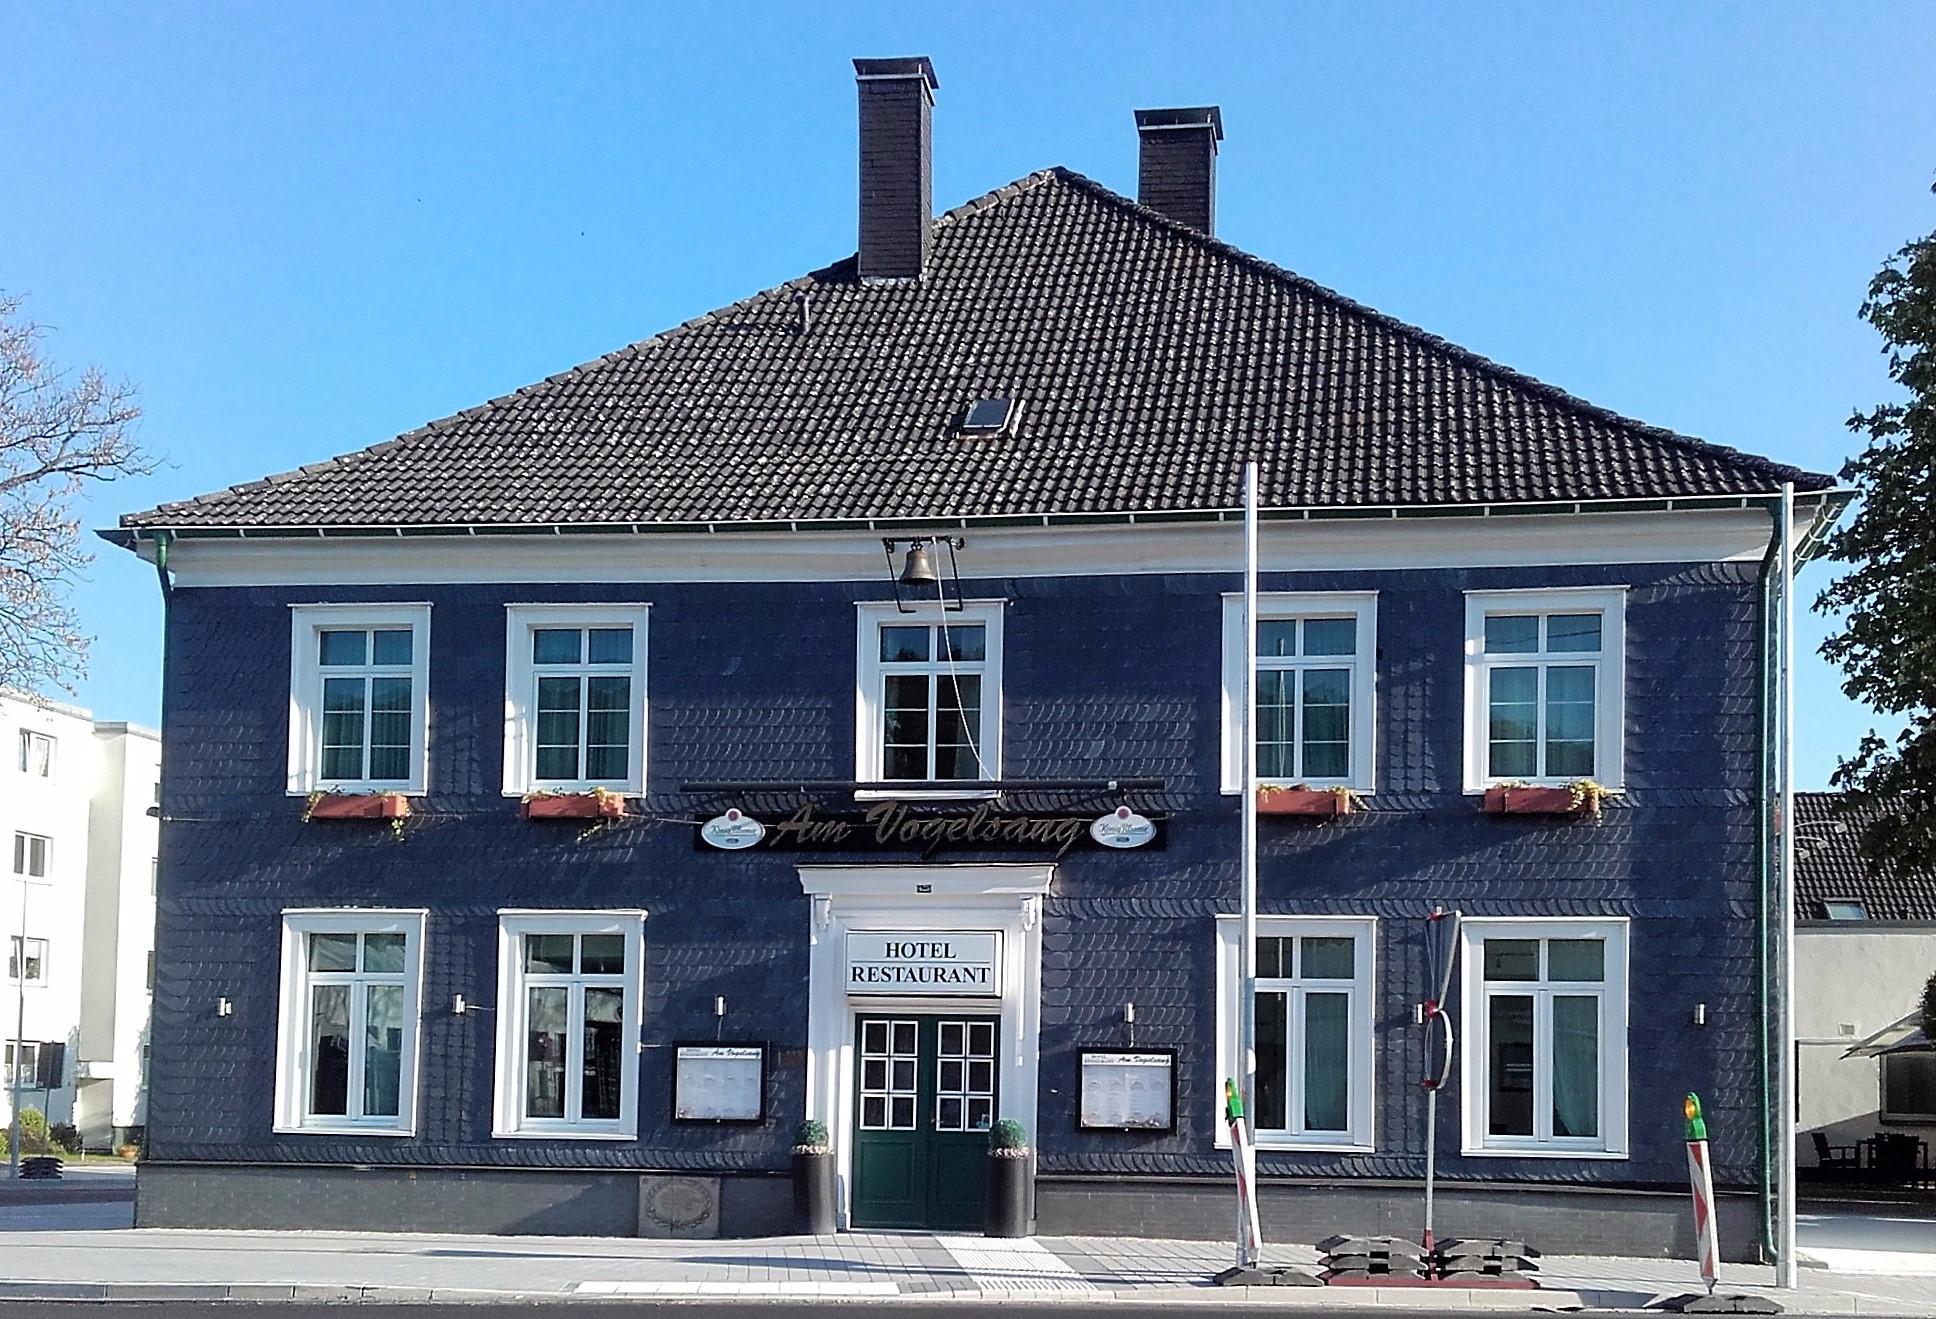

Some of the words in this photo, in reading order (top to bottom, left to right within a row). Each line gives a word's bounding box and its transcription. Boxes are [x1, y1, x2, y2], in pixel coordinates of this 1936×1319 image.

[769, 802, 851, 847] Am
[865, 799, 1086, 860] Vogelsang
[885, 942, 957, 959] HOTEL
[851, 966, 991, 983] RESTAURANT
